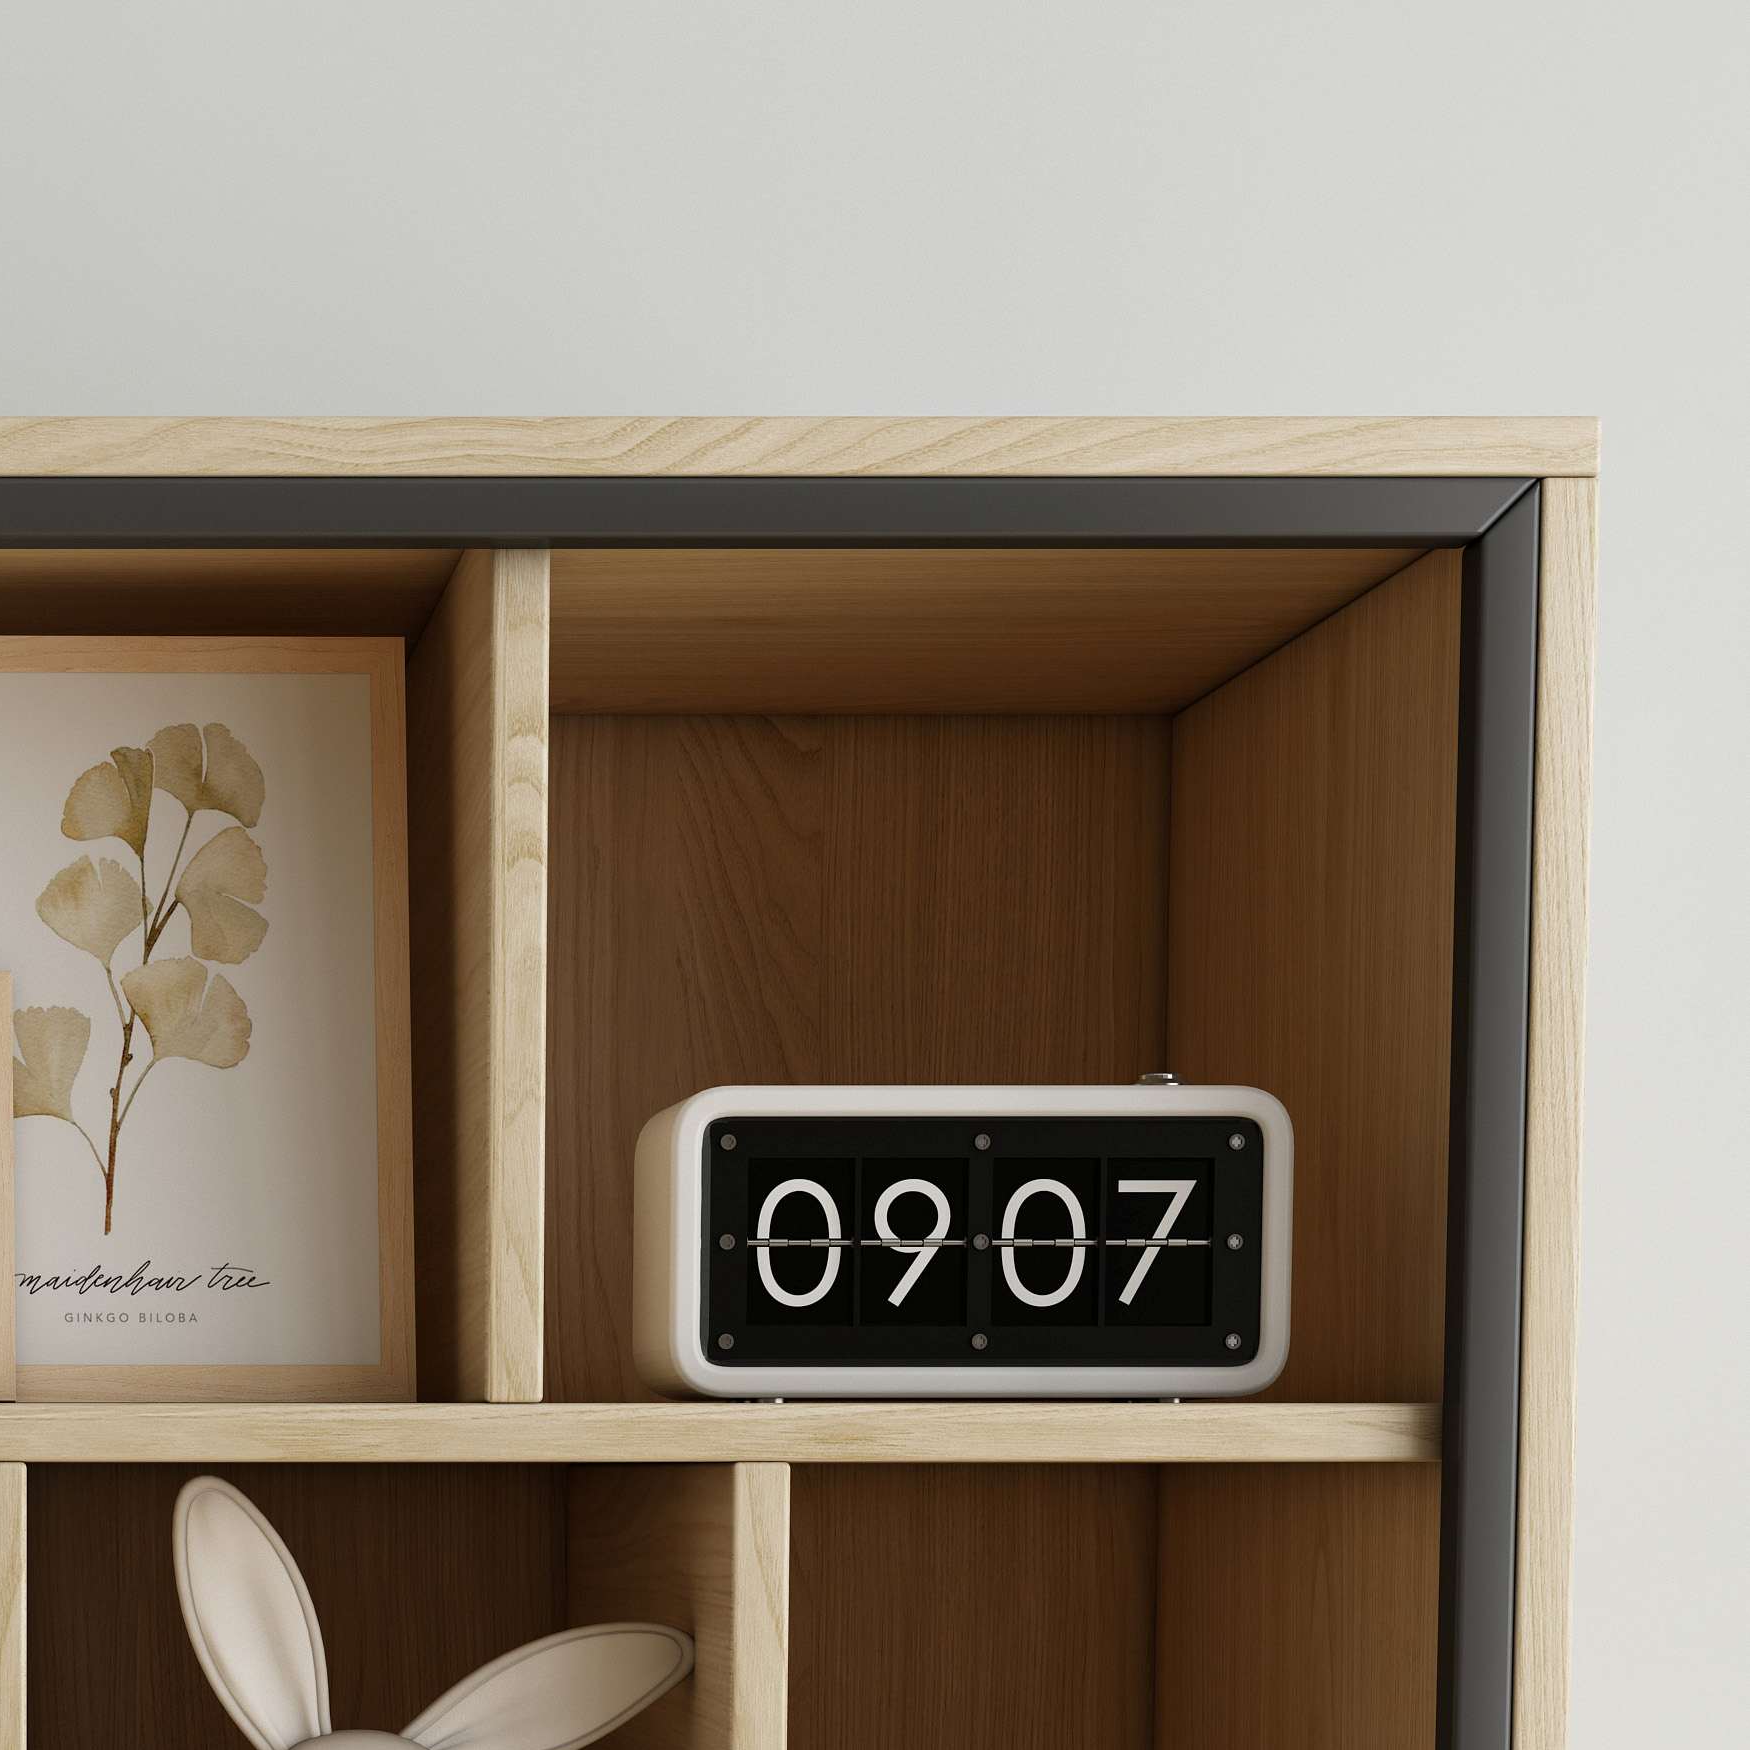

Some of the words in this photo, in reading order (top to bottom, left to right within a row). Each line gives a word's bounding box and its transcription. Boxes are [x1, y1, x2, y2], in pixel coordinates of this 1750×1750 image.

[14, 1260, 202, 1295] maidenhair
[207, 1262, 270, 1291] tree
[65, 1312, 129, 1323] GINKGO
[138, 1312, 199, 1323] BILOBA
